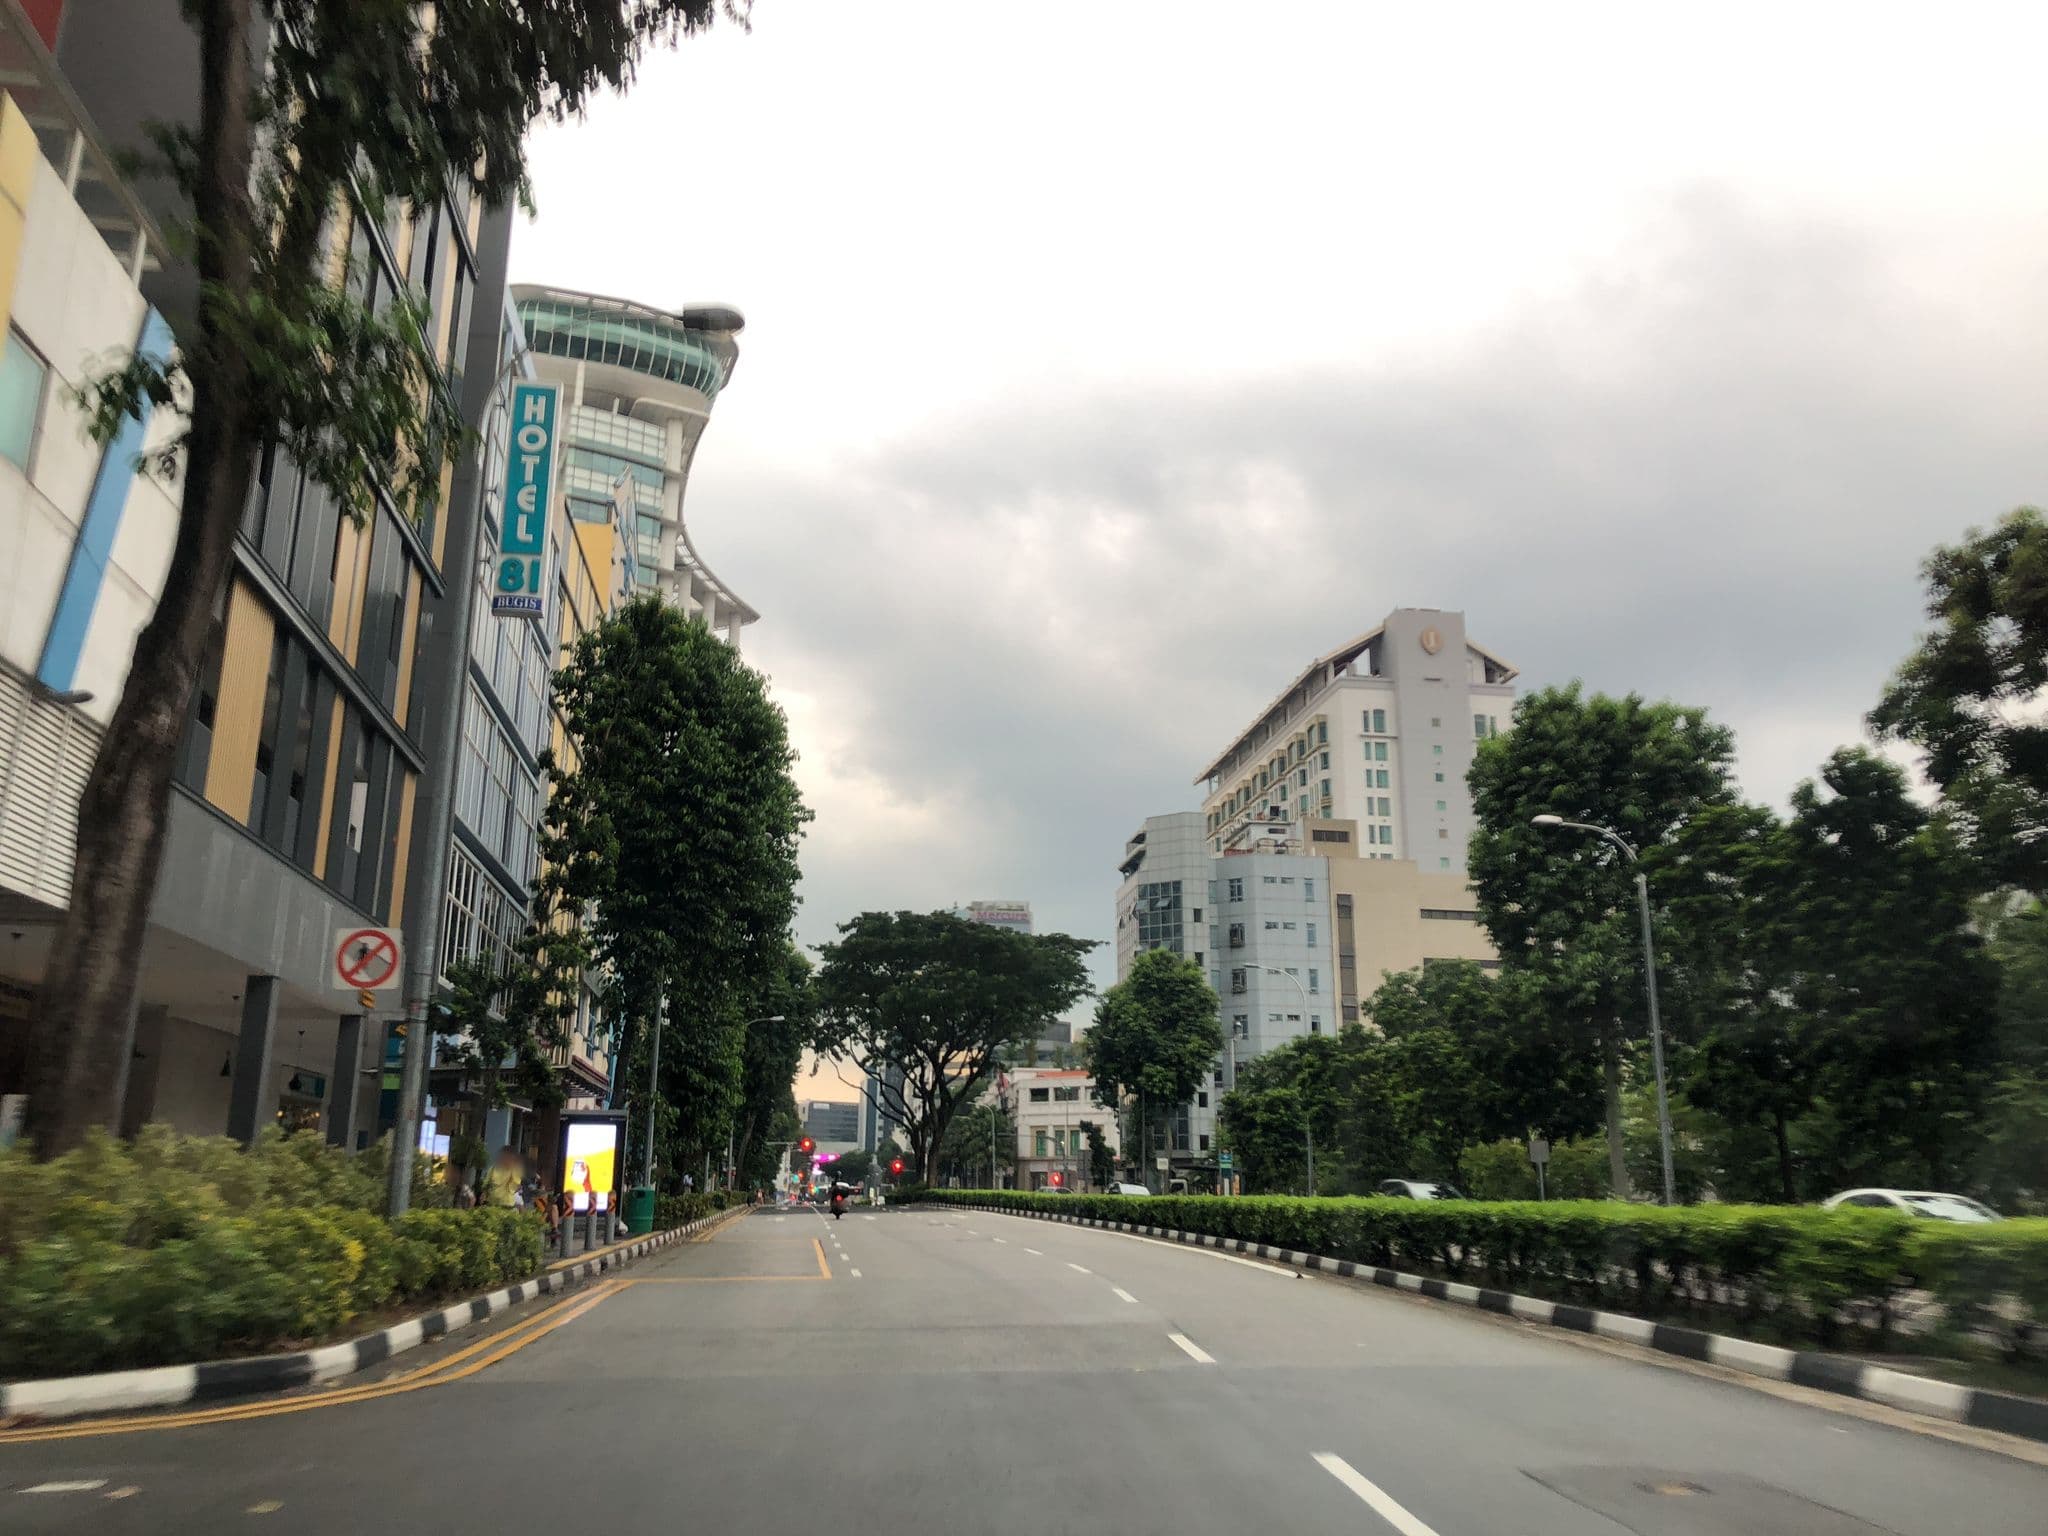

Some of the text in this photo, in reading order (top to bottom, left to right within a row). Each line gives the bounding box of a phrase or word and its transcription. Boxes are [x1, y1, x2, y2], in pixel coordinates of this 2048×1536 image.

[517, 394, 547, 543] HOTEL
[498, 558, 540, 593] 81
[497, 596, 537, 609] BUGIS
